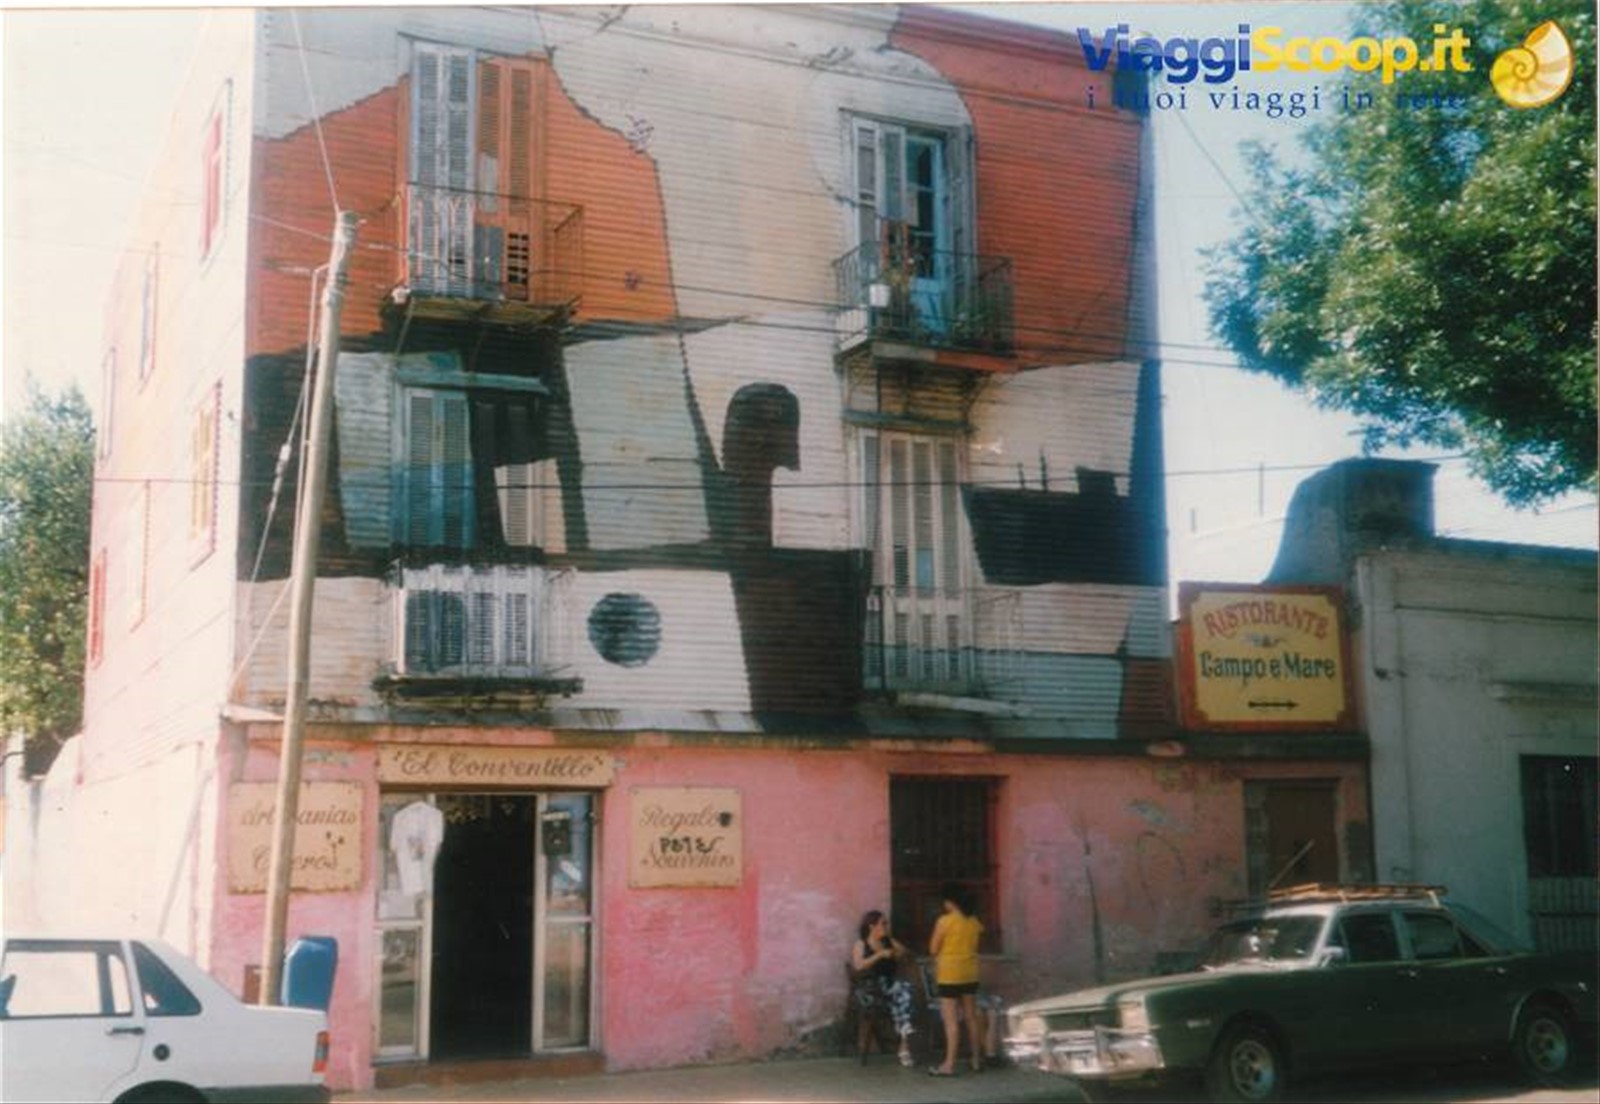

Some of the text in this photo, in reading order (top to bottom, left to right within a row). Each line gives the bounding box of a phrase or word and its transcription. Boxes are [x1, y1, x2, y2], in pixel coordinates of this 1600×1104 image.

[1203, 601, 1330, 641] RISTORANTE
[1201, 651, 1335, 686] Campo e Mare
